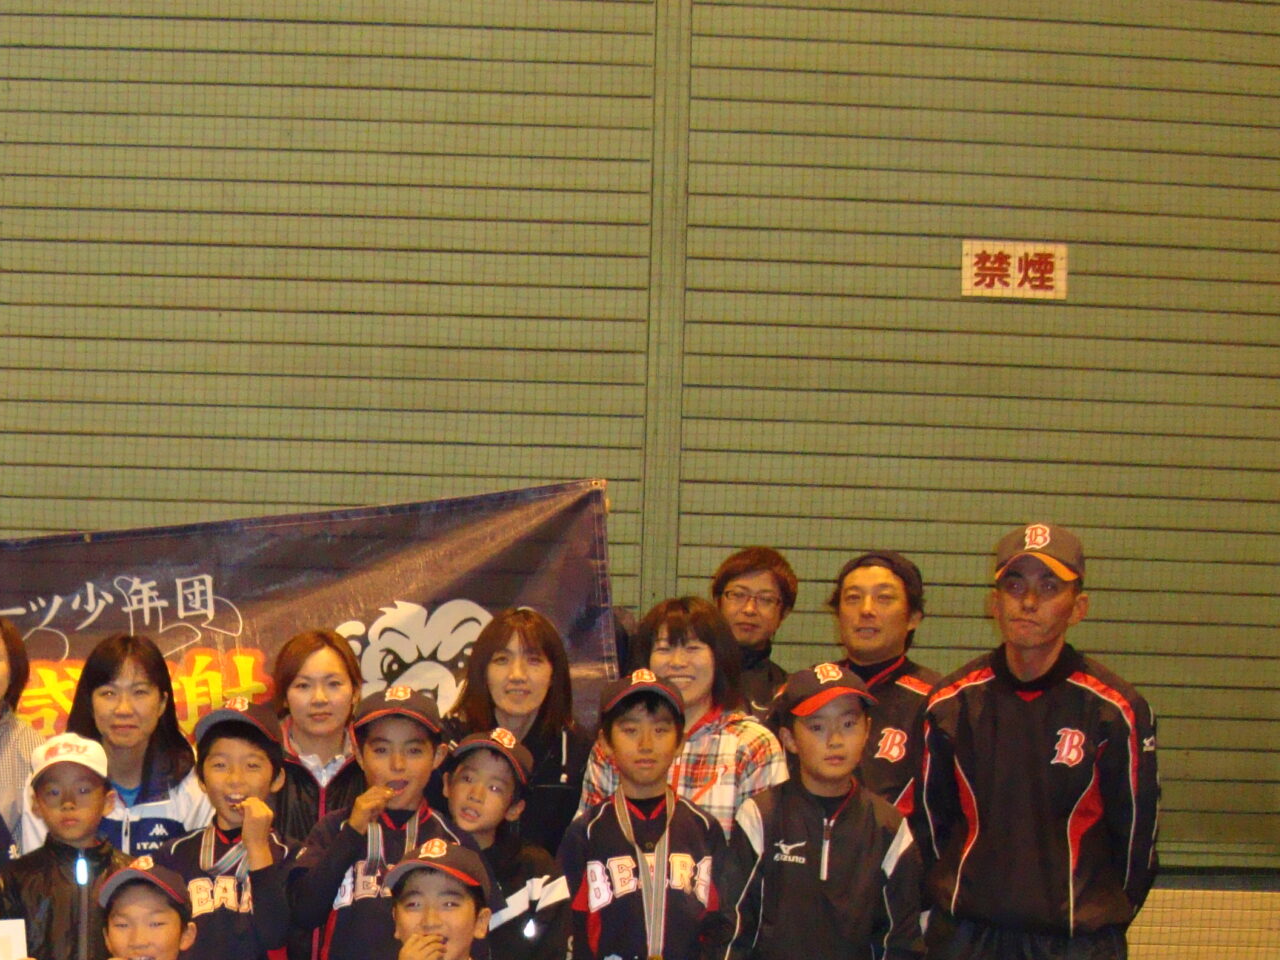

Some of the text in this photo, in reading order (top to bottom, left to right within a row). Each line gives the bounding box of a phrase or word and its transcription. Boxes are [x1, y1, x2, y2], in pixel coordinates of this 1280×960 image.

[973, 249, 1055, 291] 禁煙
[1024, 523, 1051, 551] B
[873, 727, 909, 763] B
[1050, 727, 1086, 768] B
[136, 841, 164, 851] ITA
[587, 852, 712, 913] BERS
